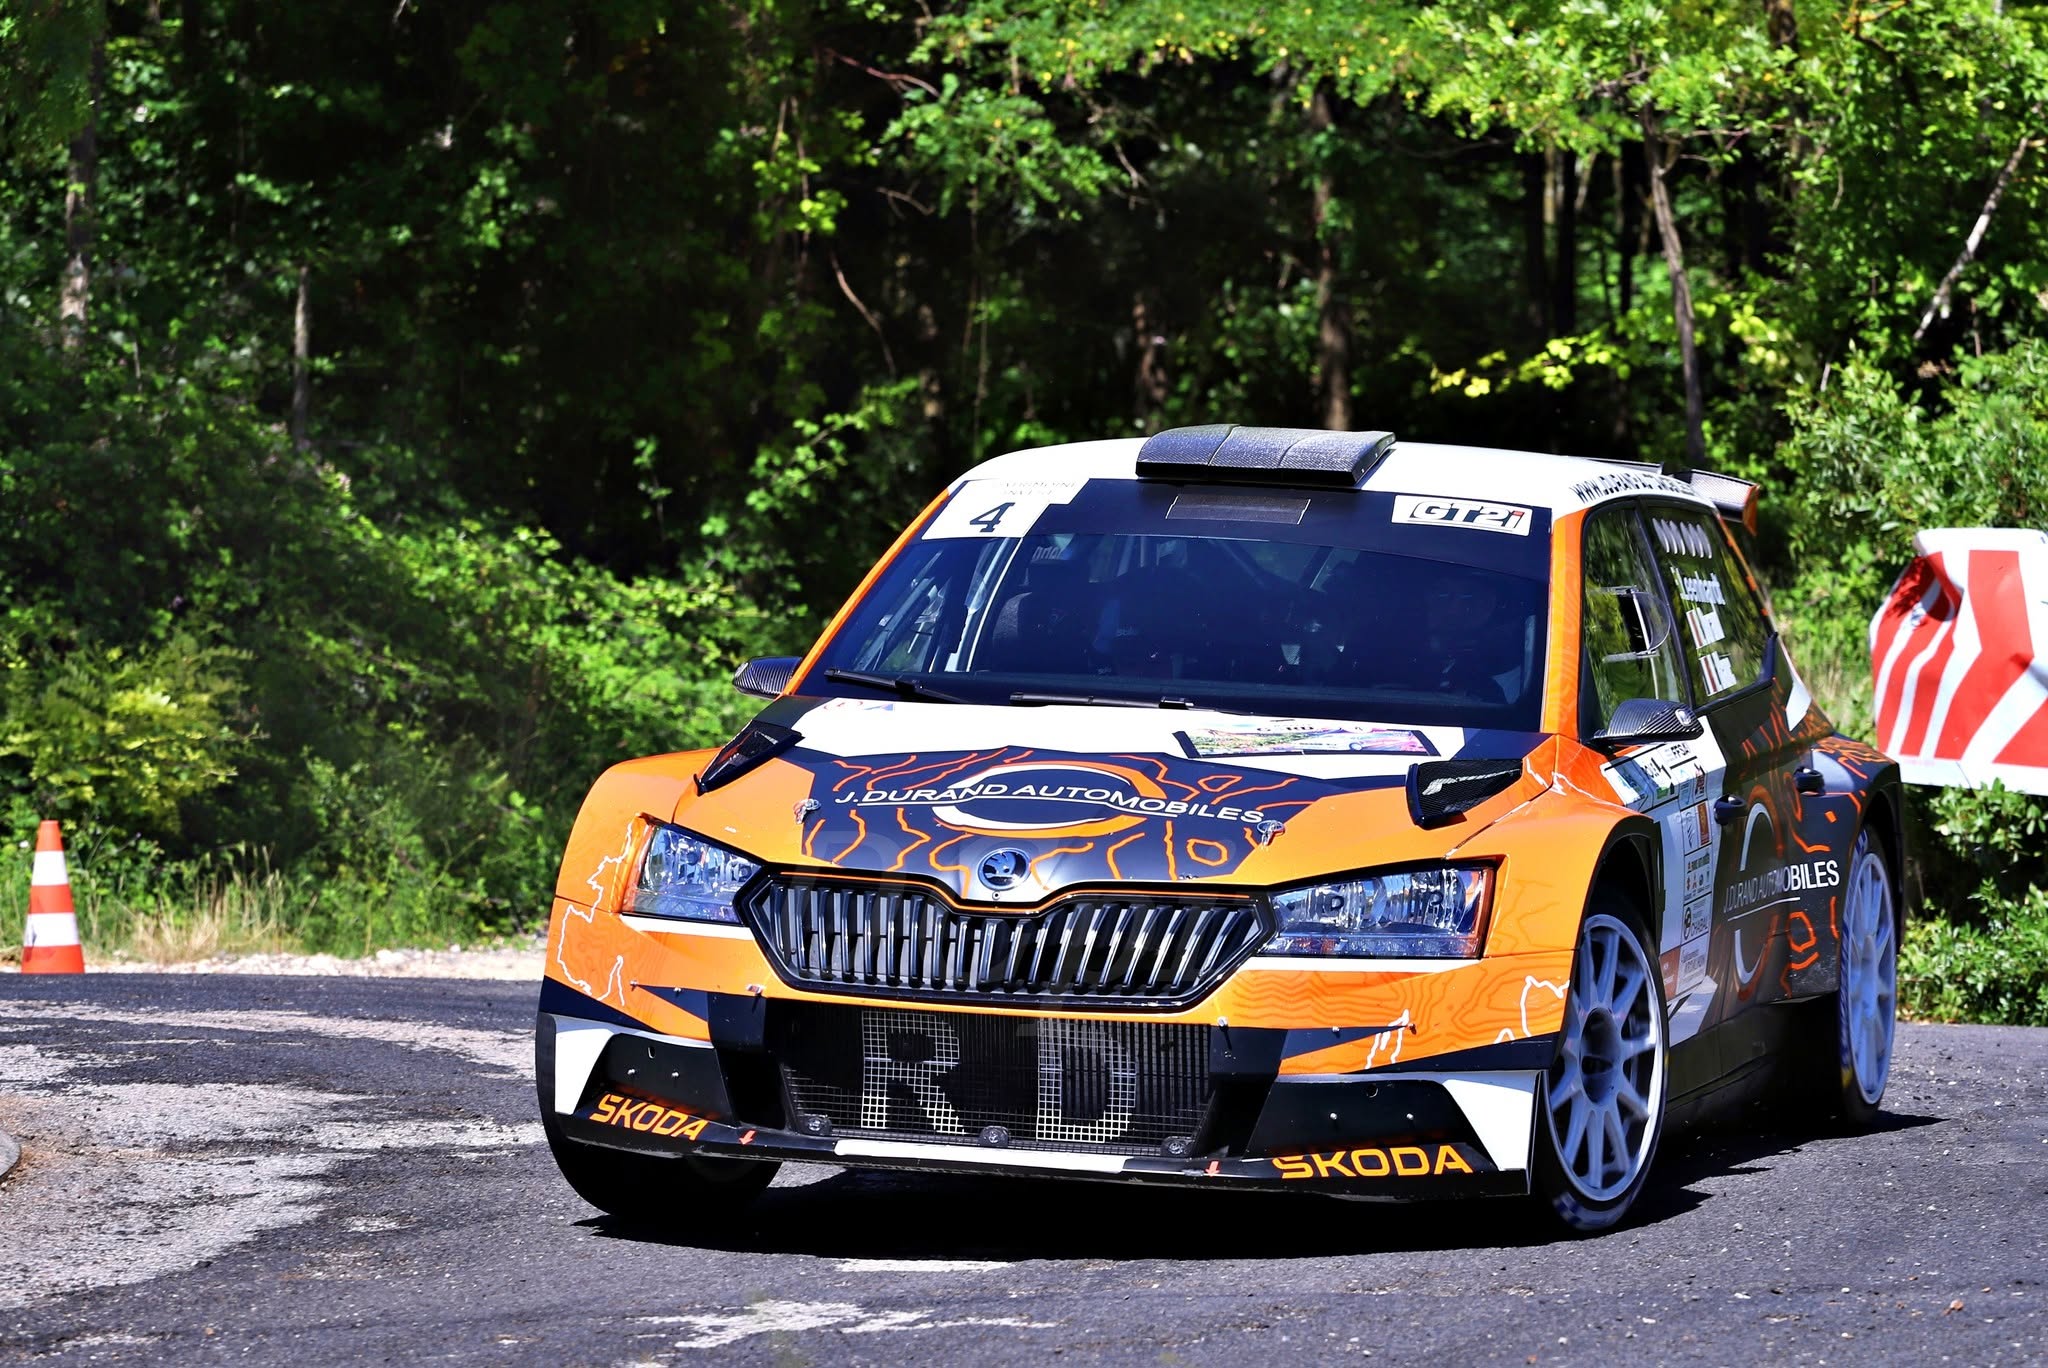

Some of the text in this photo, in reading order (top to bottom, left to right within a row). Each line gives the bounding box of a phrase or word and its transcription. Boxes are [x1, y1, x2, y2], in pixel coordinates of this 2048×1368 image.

[969, 502, 1016, 533] 4
[1409, 501, 1525, 529] GT2i
[835, 784, 1265, 823] J.DURAND AUTOMOBILES
[860, 1010, 1137, 1144] R D
